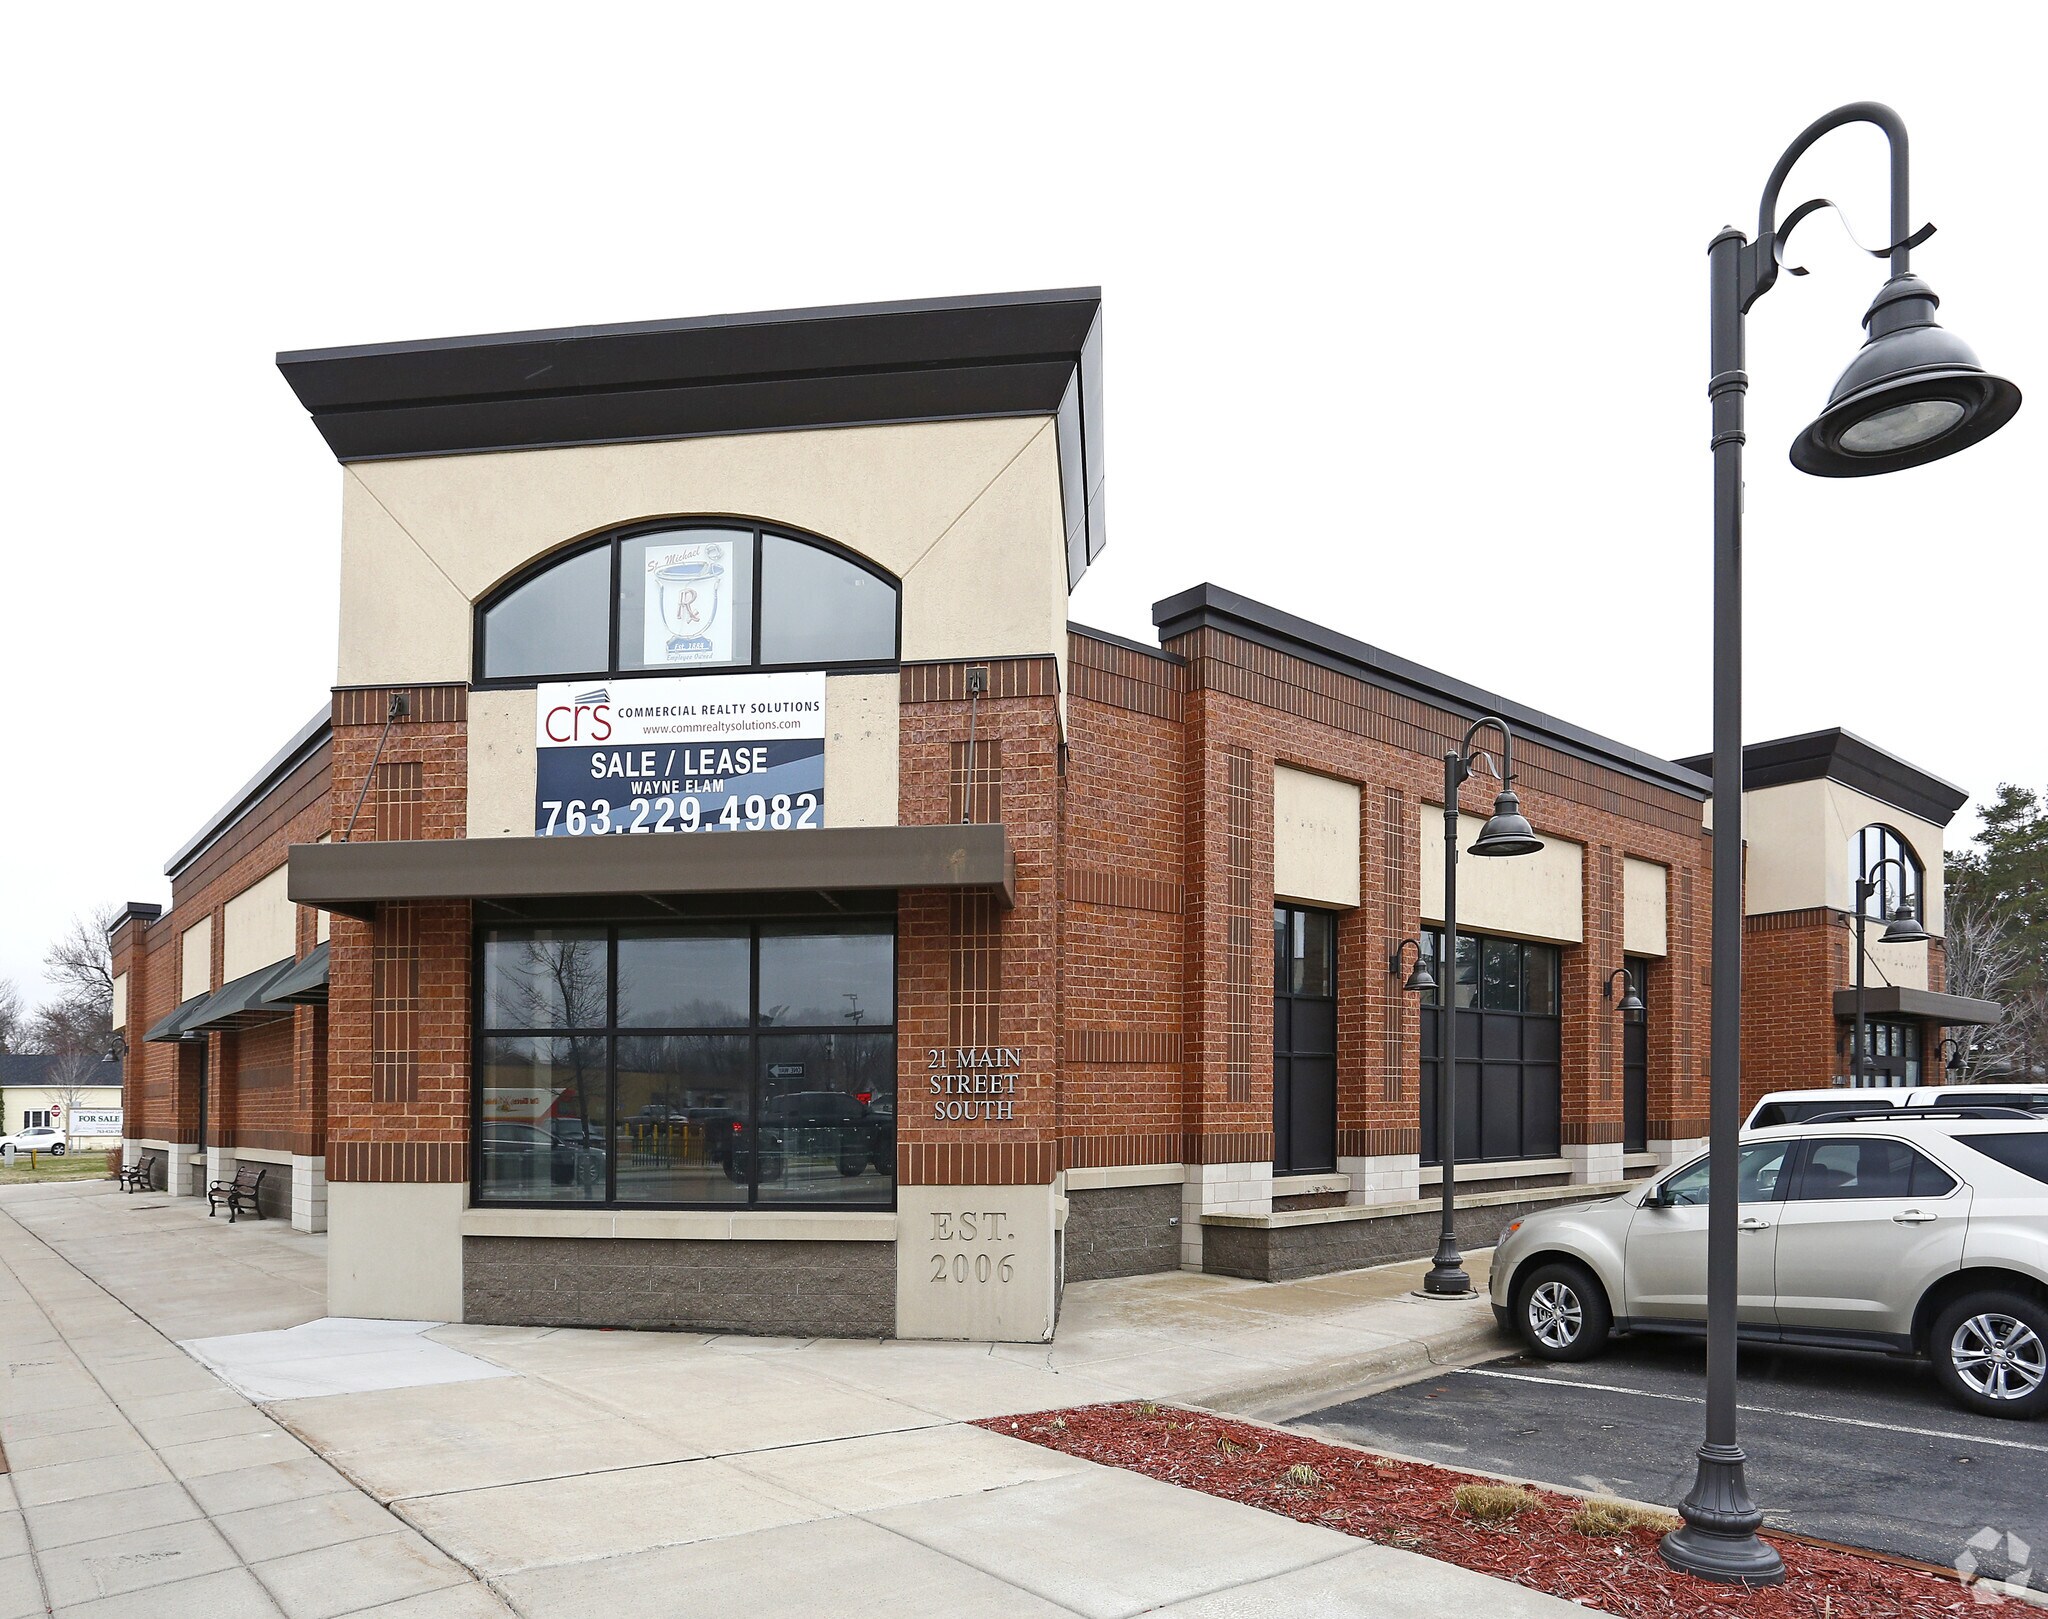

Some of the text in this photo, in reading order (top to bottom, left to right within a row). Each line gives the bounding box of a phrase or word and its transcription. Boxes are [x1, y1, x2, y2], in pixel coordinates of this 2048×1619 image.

[665, 546, 700, 564] Michael
[666, 652, 714, 662] Employee Owned
[618, 701, 820, 718] COMMERCIAL REALTY SOLUTIONS
[546, 704, 612, 742] crs
[643, 719, 801, 735] www.commrealtysolutions.com
[590, 747, 768, 779] SALE / LEASE
[630, 778, 724, 795] WAYNE ELAM
[542, 793, 818, 836] 763.229.4982
[928, 1048, 1022, 1069] 21 MAIN
[930, 1074, 1019, 1095] STREET
[934, 1100, 1014, 1121] SOUTH
[930, 1211, 1015, 1242] EST.
[930, 1253, 1016, 1284] 2006
